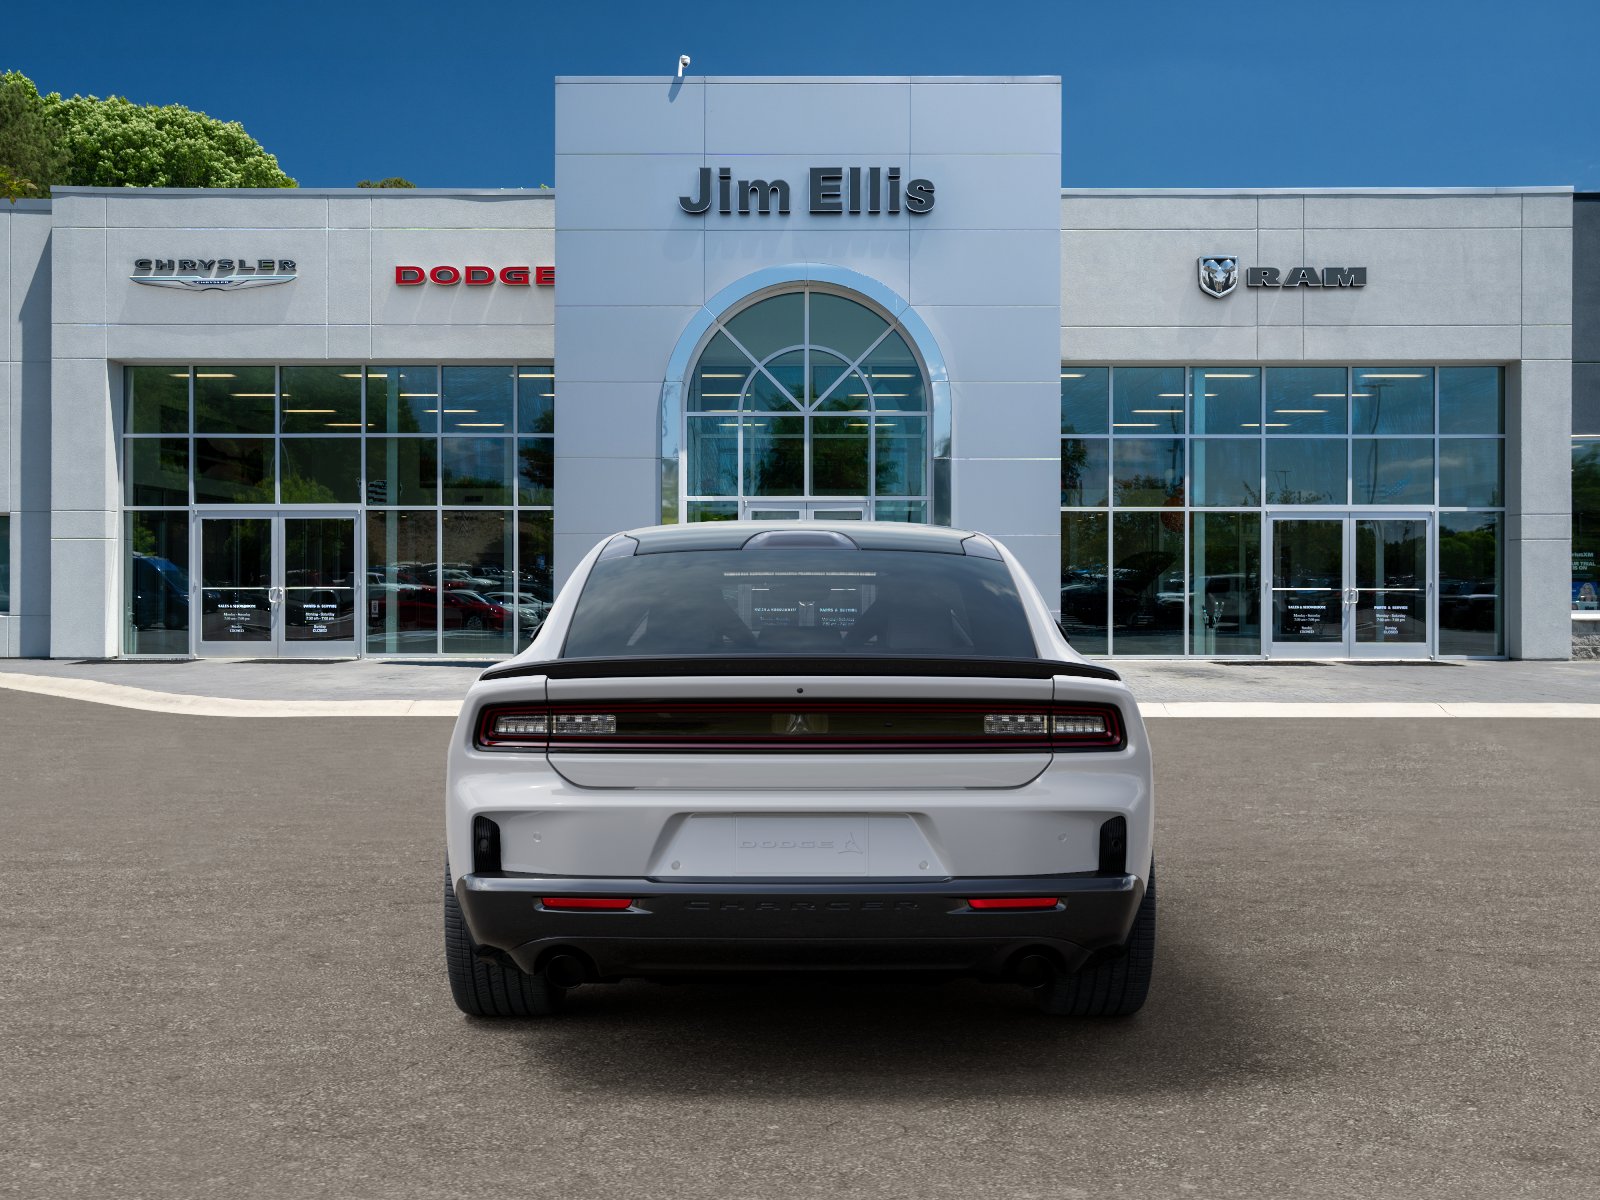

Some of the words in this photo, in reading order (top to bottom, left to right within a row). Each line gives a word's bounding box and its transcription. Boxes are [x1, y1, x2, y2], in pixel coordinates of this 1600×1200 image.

[679, 167, 790, 213] Jim
[809, 167, 935, 213] Ellis
[134, 258, 297, 271] CHRYSLER
[395, 265, 555, 286] DODGE
[1247, 267, 1367, 287] RAM
[740, 840, 834, 849] DODGE
[687, 902, 919, 911] CHARGER
